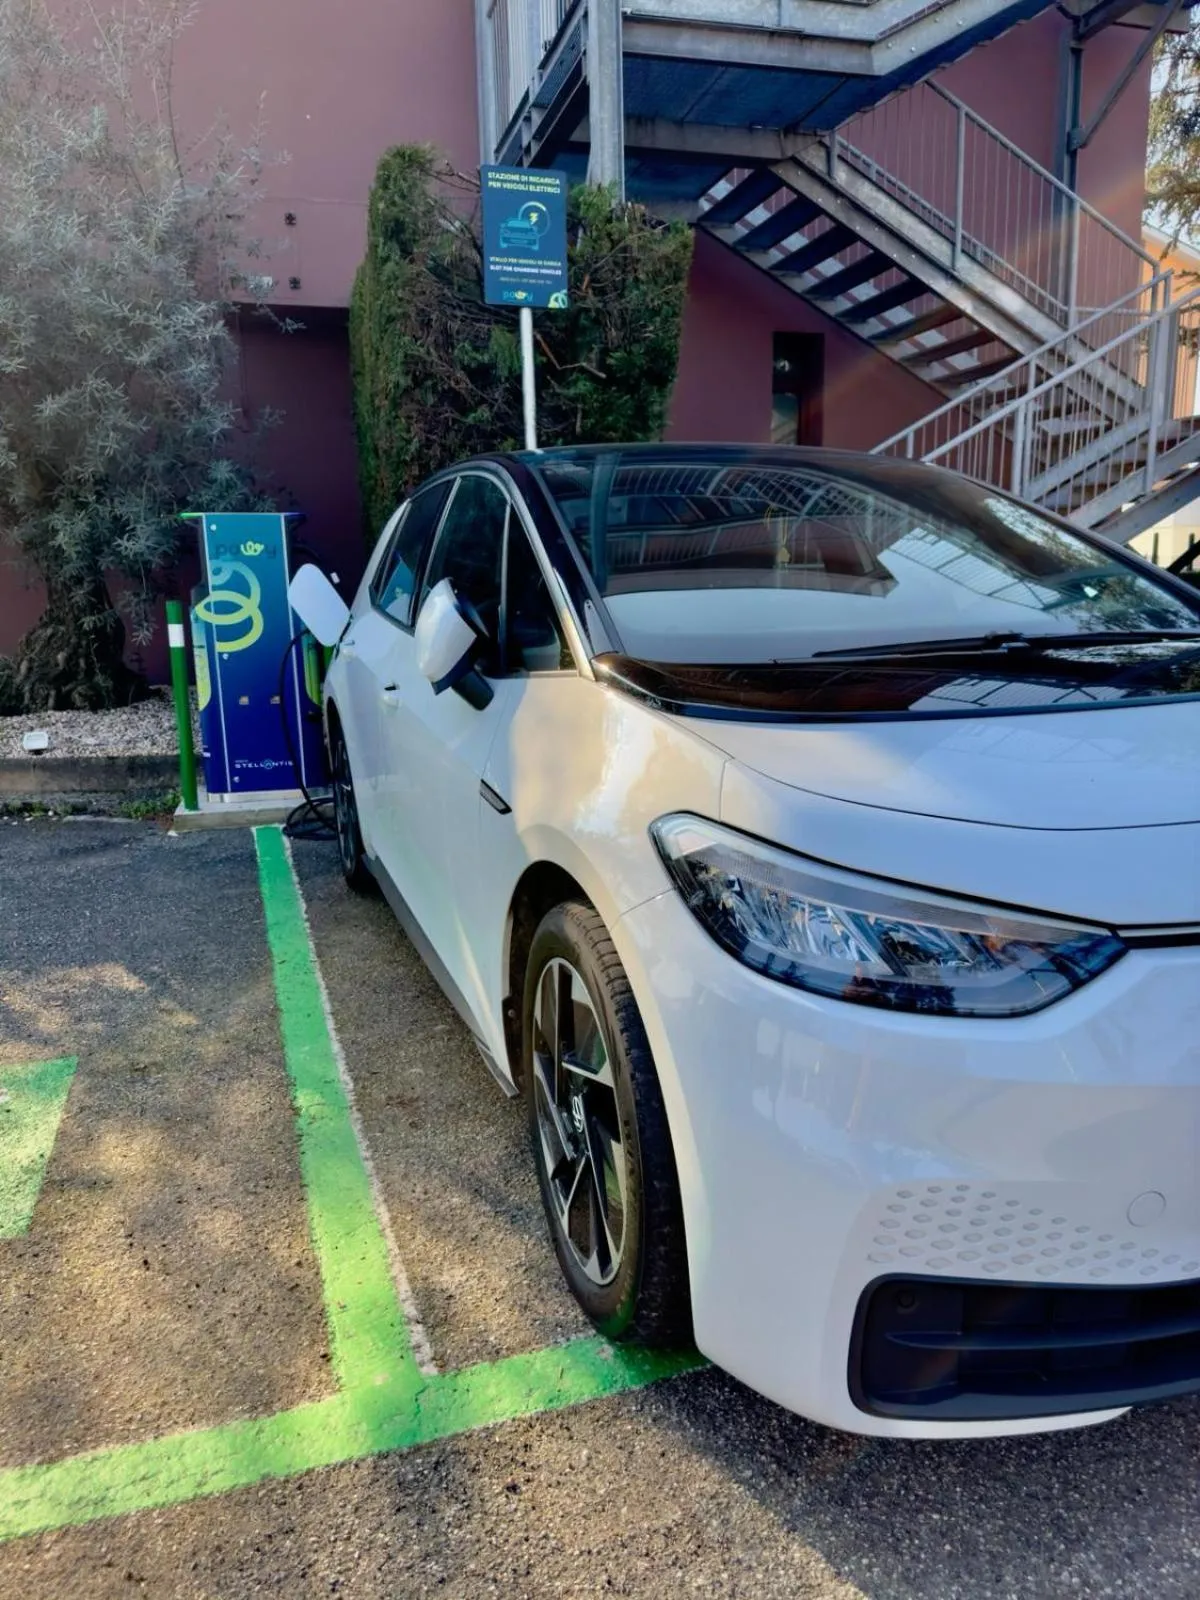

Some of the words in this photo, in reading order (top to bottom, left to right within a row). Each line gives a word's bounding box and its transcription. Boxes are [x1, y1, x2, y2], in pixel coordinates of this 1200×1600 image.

[488, 172, 520, 181] STAZIONE
[520, 174, 528, 182] DI
[529, 175, 560, 185] RICARICA
[502, 183, 529, 191] VEICOLI
[529, 184, 560, 194] ELETTRICI
[234, 759, 294, 769] STELLANTIS
